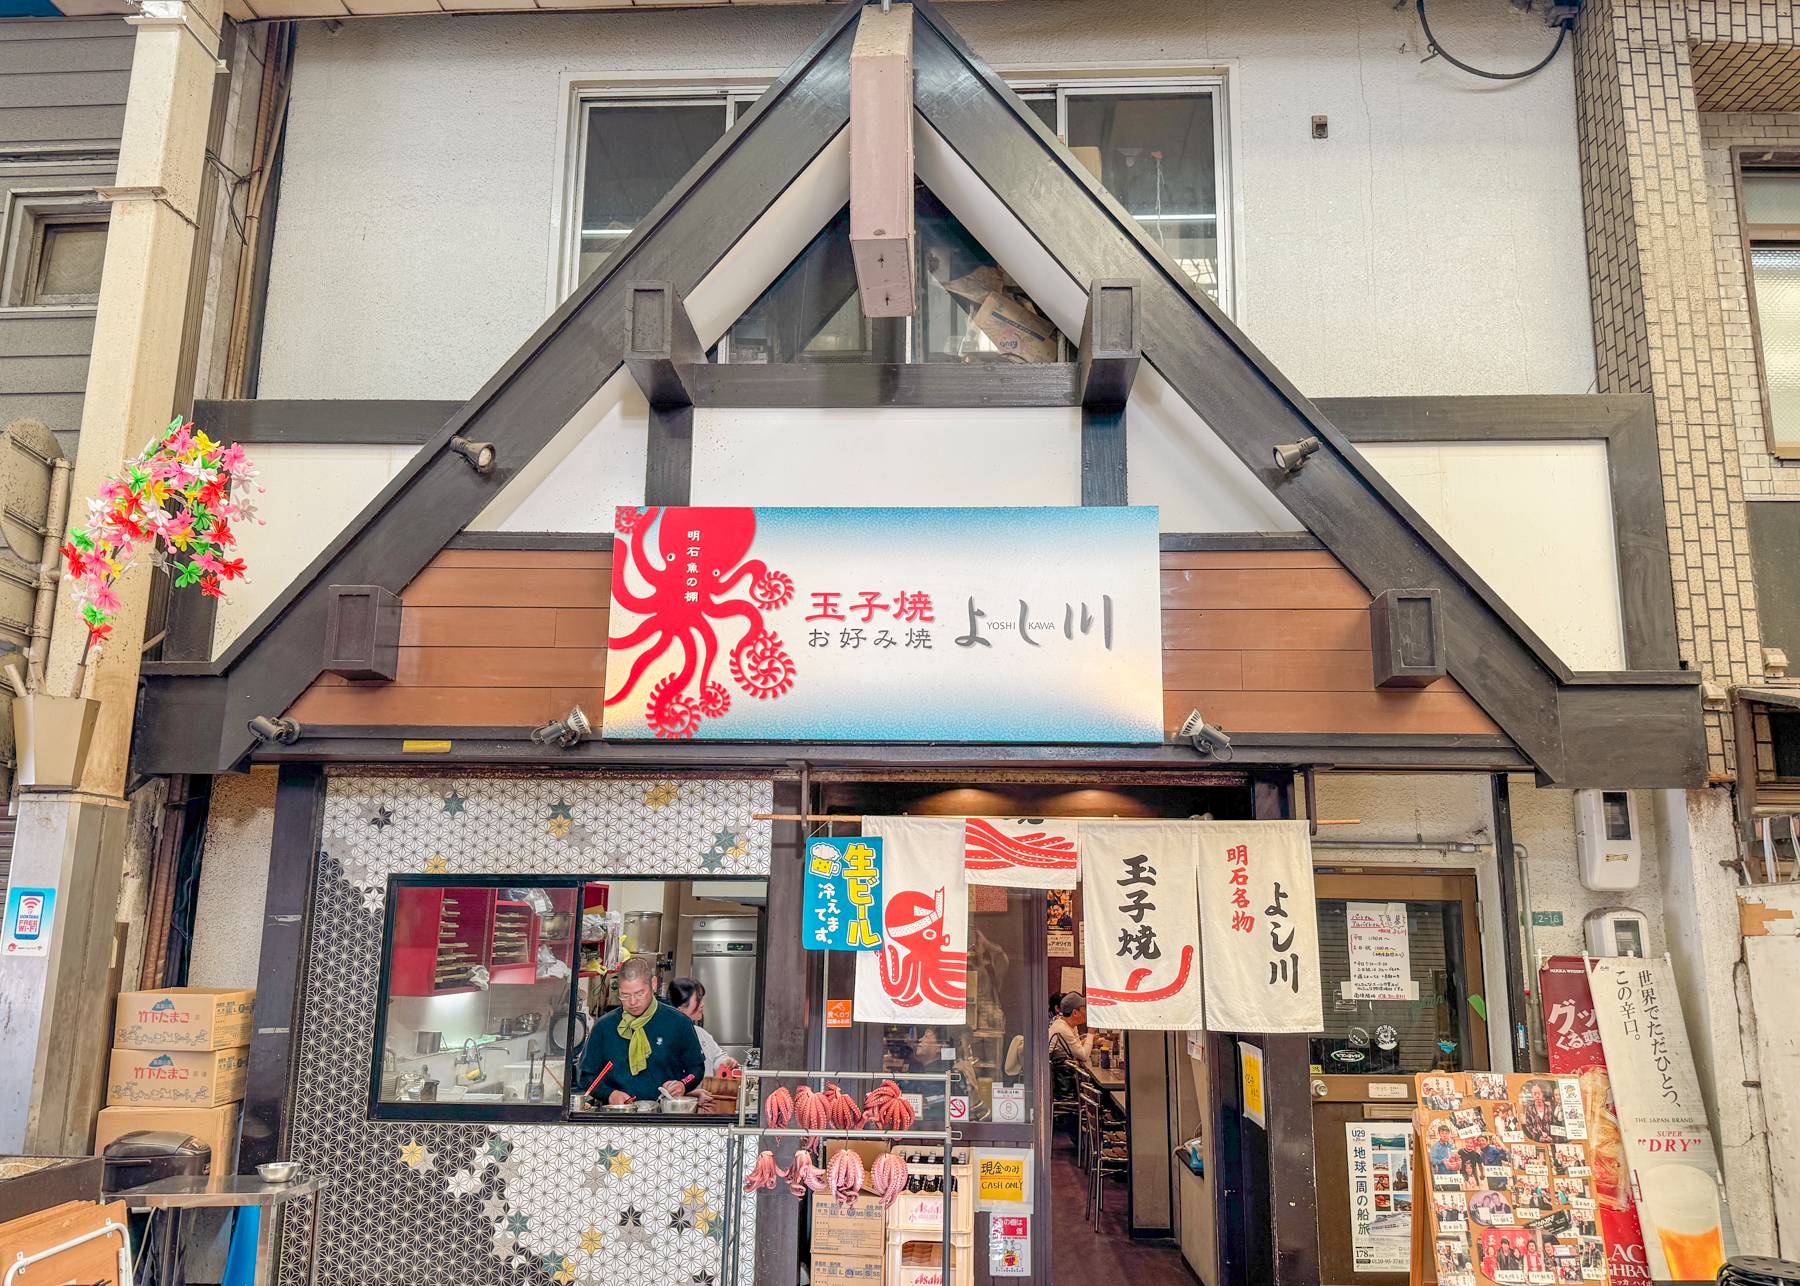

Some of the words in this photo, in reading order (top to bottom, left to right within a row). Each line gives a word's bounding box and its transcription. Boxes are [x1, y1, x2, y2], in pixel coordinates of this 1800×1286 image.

[684, 530, 701, 602] 明石魚の棚
[805, 590, 935, 623] 玉子焼
[808, 627, 933, 649] お好み焼
[954, 595, 1113, 650] よし川
[986, 621, 1017, 630] YOSHI
[1028, 621, 1056, 630] KAWA
[842, 843, 881, 946] 生ビール
[1116, 854, 1162, 961] 玉子焼
[1226, 844, 1255, 934] 明石名物
[1264, 881, 1299, 994] よし川
[1616, 970, 1641, 1041] この辛口。
[1638, 970, 1681, 1108] 世界でただひとつ、
[980, 1161, 1020, 1175] 現金のみ
[981, 1181, 1003, 1190] CASH
[1005, 1180, 1024, 1191] ONLY
[1353, 1146, 1370, 1236] 地球一周の船旅
